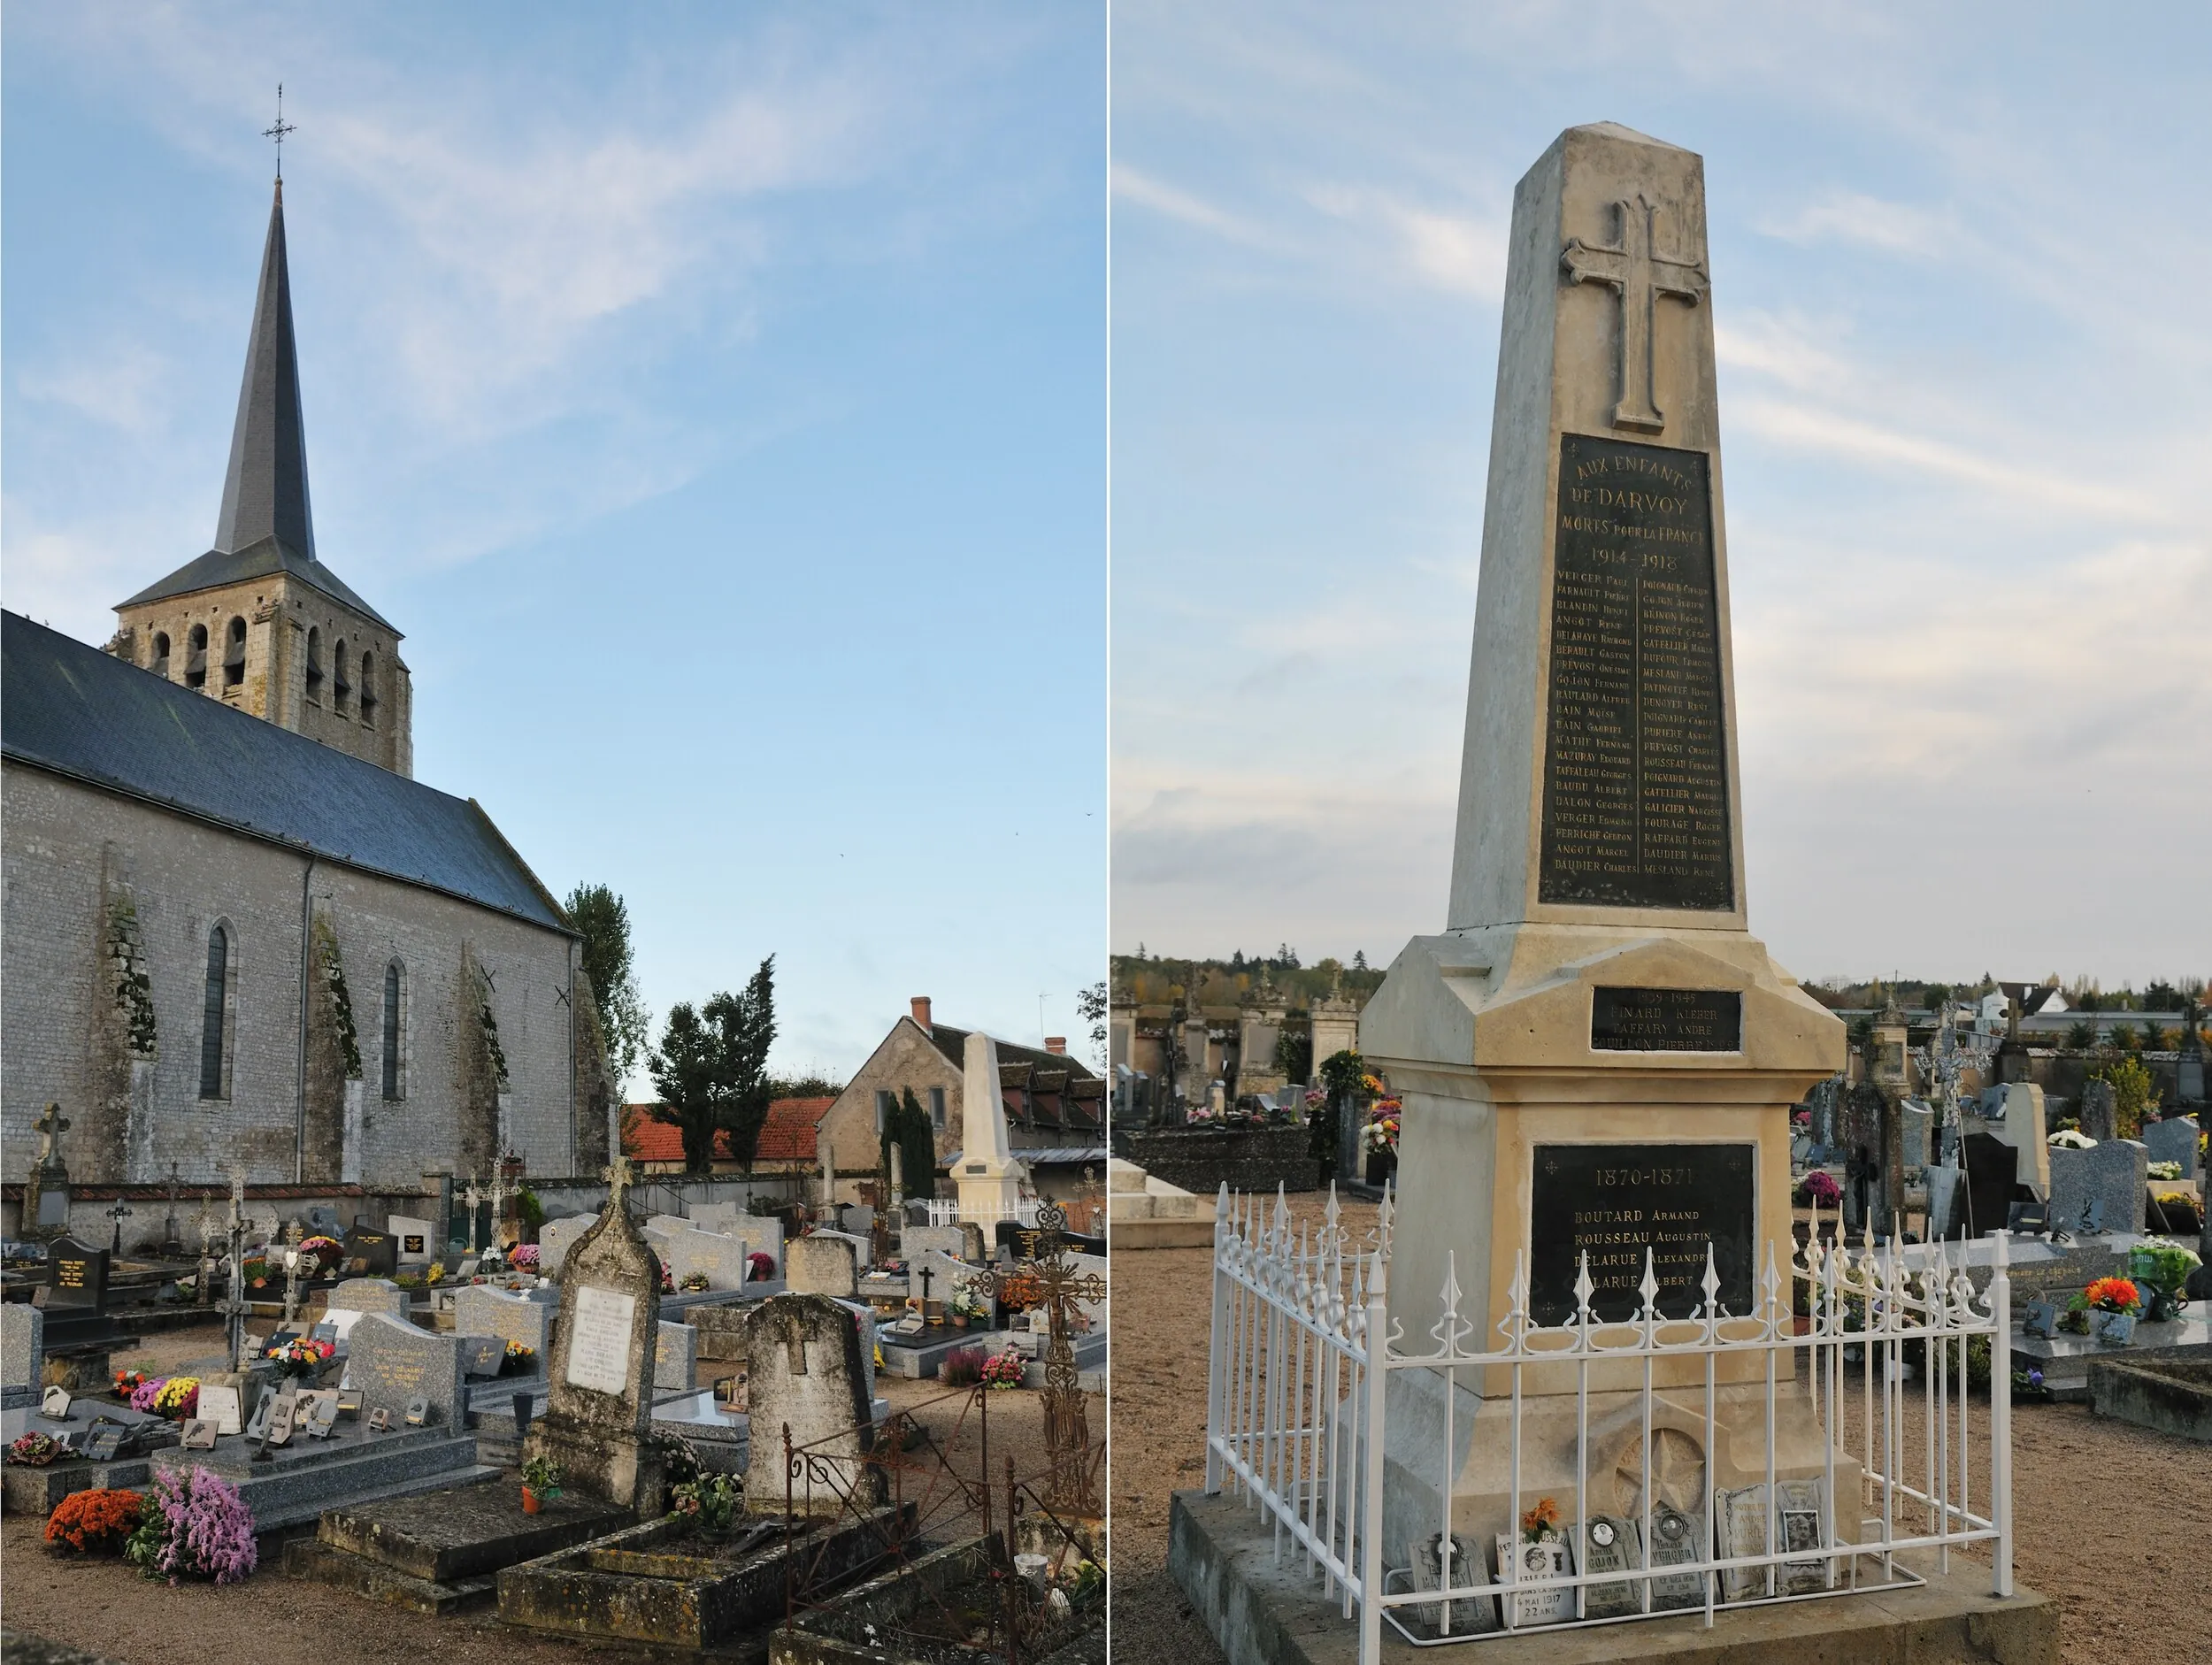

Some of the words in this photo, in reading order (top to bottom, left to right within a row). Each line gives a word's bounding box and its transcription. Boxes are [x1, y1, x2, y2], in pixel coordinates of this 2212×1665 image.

[1577, 457, 1608, 480] AUX
[1615, 456, 1692, 491] ENFANTS
[1571, 487, 1593, 503] DE
[1599, 488, 1687, 515] DARVOY
[1562, 515, 1609, 534] MORTS
[1614, 524, 1640, 539] POUR
[1643, 526, 1655, 540] LA
[1557, 570, 1601, 584] VERGER
[1557, 600, 1599, 612] BLANDIN
[1556, 615, 1592, 627] ANGOT
[1557, 630, 1598, 642] DELAHAYE
[1643, 653, 1678, 665] DUFOUR
[1644, 756, 1686, 769] ROUSSEAU
[1644, 771, 1684, 783] POIGNARD
[1594, 784, 1627, 794] ALBERT
[1556, 796, 1591, 808] DALON
[1596, 800, 1633, 810] GEORGES
[1555, 812, 1595, 824] VERGER
[1645, 817, 1688, 829] FOURAGE
[1556, 844, 1592, 856] ANGOT
[1596, 845, 1628, 856] MARCEL
[1603, 862, 1637, 872] CHARLES
[1595, 1168, 1693, 1185] 1870-1871
[1574, 1210, 1643, 1224] BOUTARD
[1652, 1209, 1700, 1222] ARMAND
[1574, 1231, 1650, 1246] ROUSSEAU
[1655, 1231, 1711, 1242] AUGUSTIN
[1651, 1254, 1709, 1263] ALEXANDR
[1543, 1594, 1561, 1604] 1917
